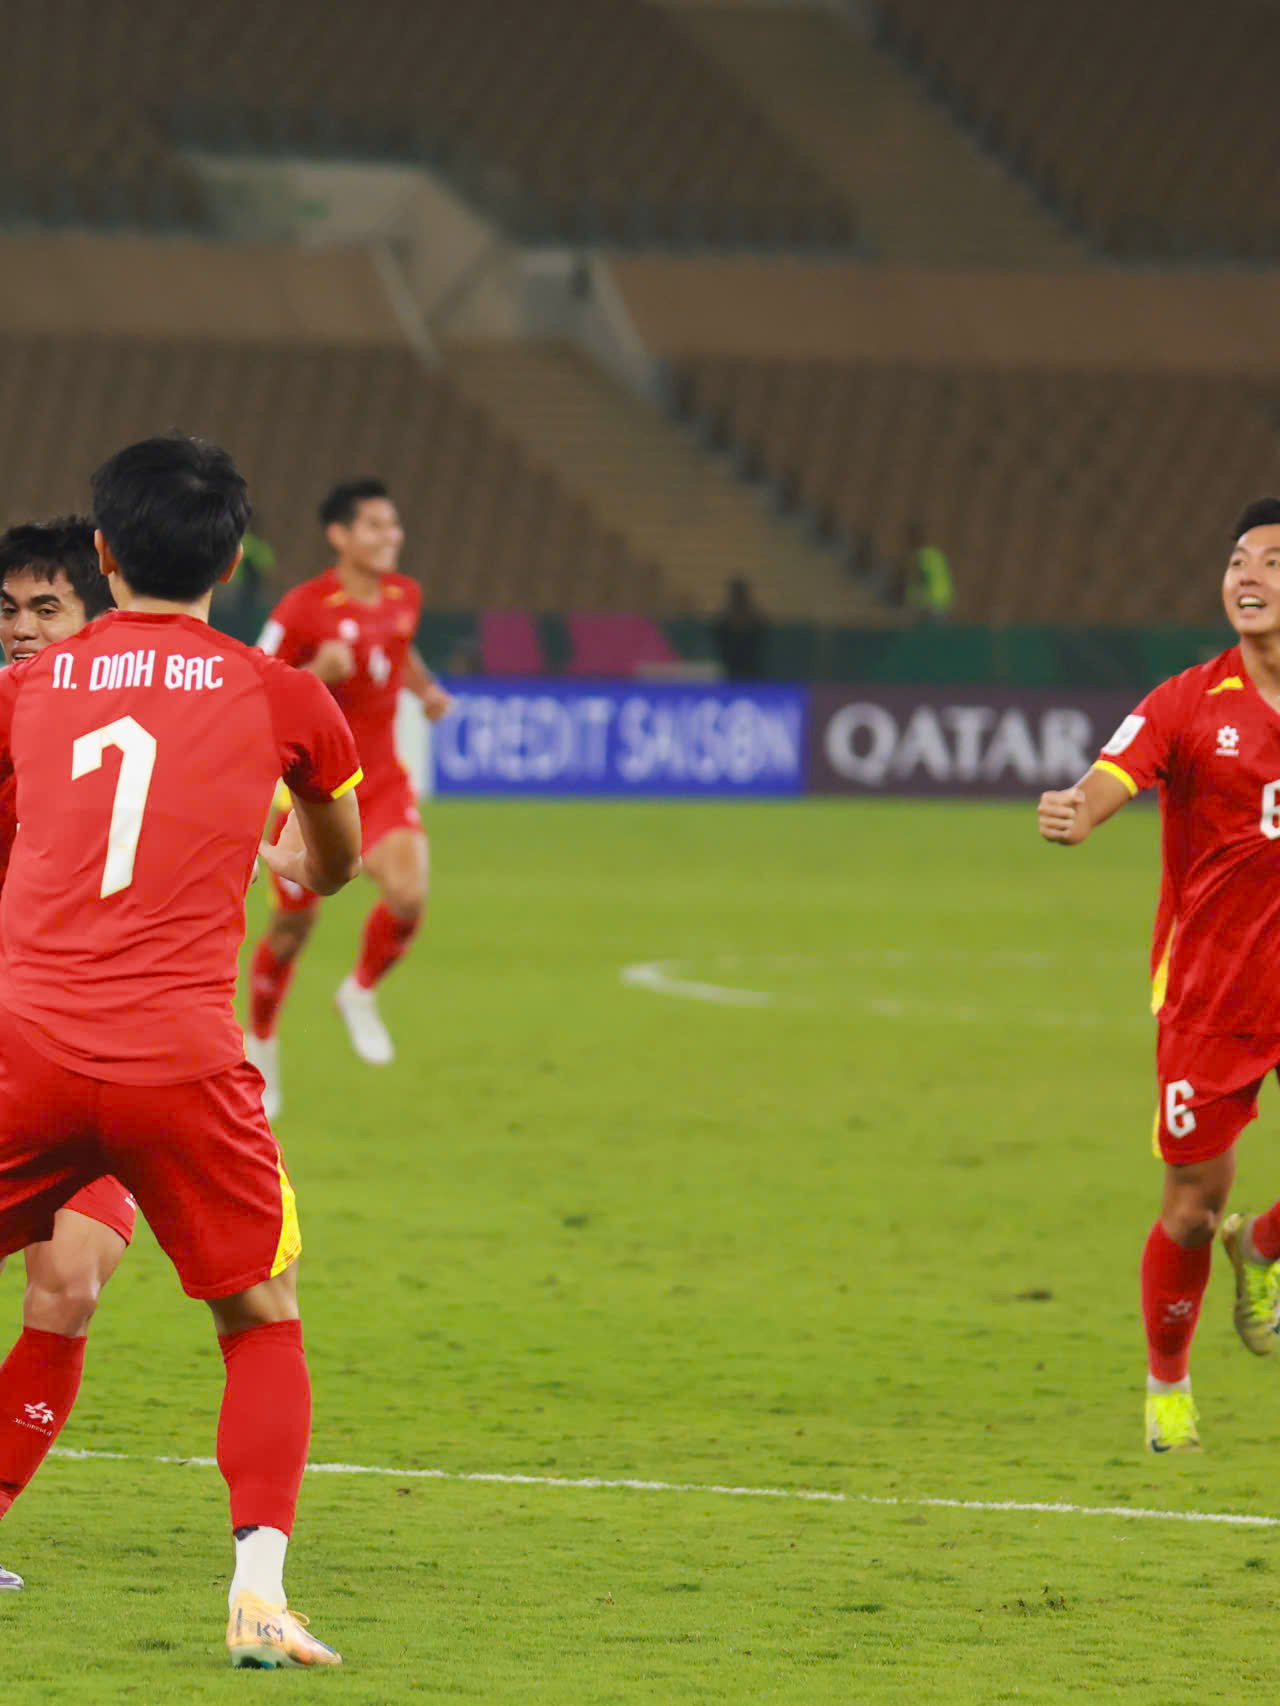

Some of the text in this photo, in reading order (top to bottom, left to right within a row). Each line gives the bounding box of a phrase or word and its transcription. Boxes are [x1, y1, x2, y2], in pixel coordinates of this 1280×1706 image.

[164, 653, 224, 691] BAC
[436, 694, 801, 784] CREDIT SAISON
[825, 701, 1094, 785] QATAR
[71, 715, 157, 899] 7
[1166, 1079, 1197, 1138] 6
